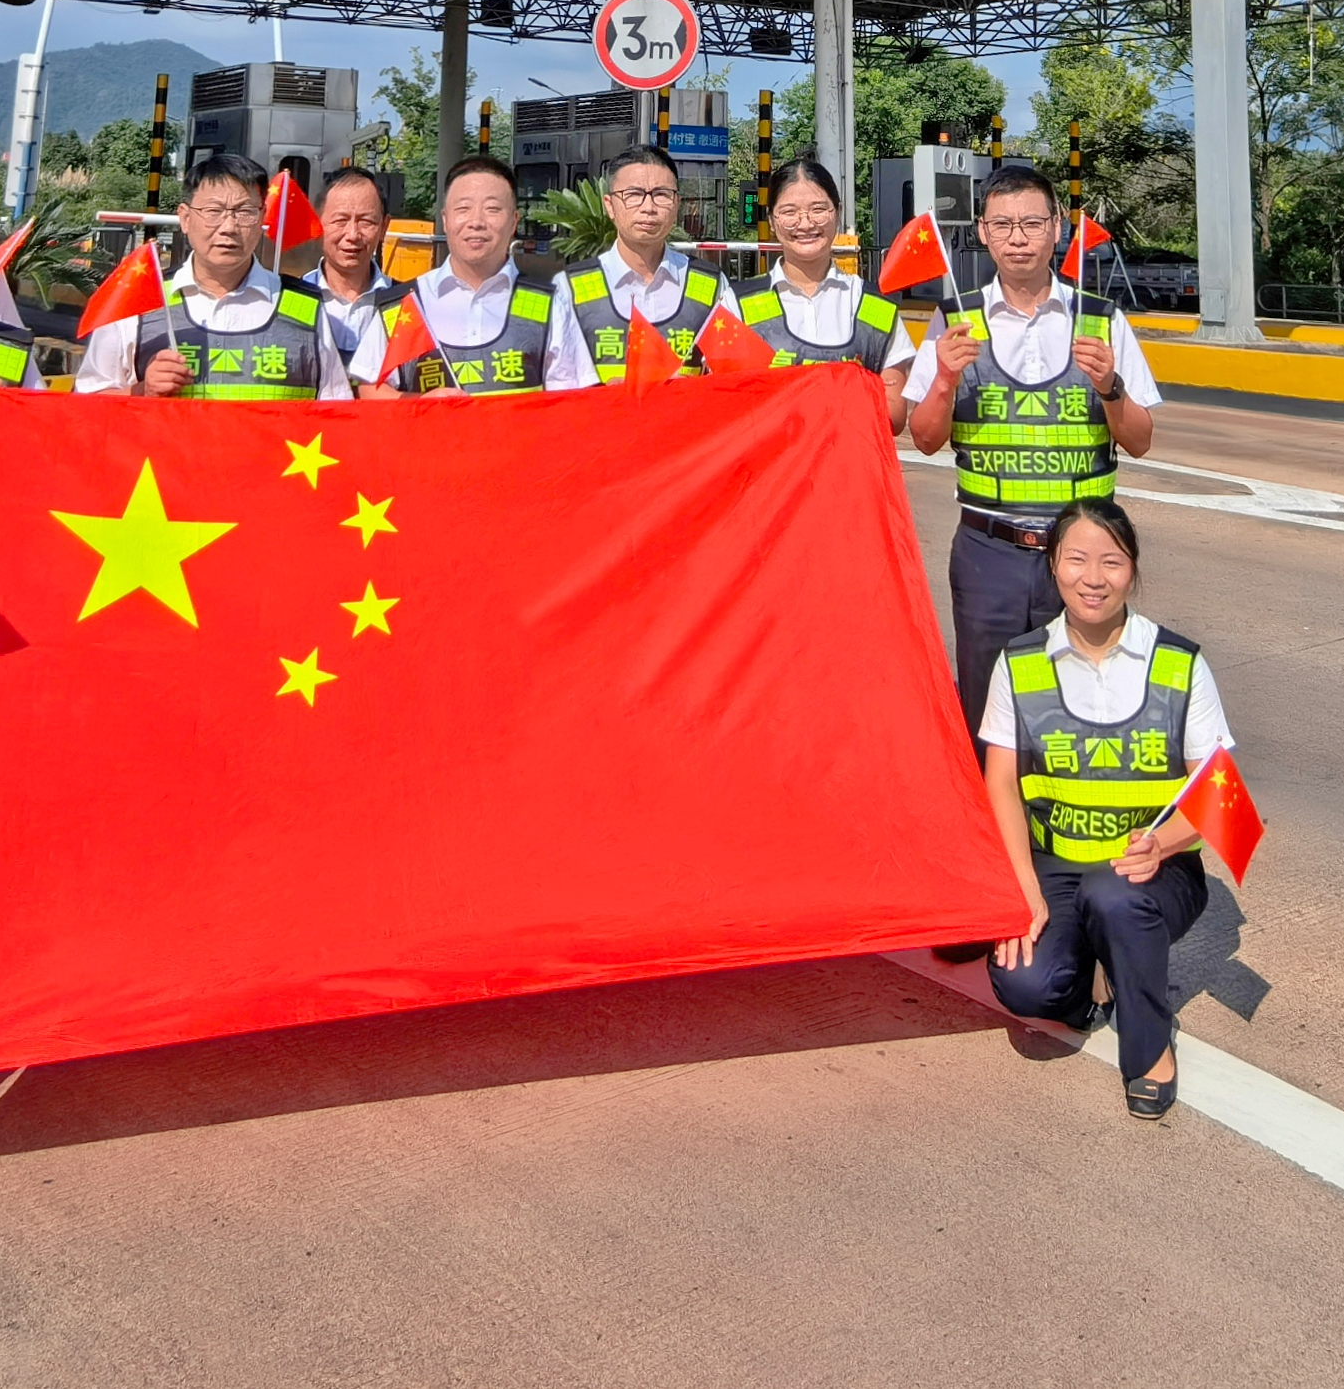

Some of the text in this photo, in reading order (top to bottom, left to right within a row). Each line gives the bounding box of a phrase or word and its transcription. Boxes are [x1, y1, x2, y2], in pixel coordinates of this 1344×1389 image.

[622, 16, 674, 61] 3m
[252, 344, 287, 380] 速
[595, 326, 624, 359] 高
[417, 348, 525, 393] 高 速
[977, 382, 1089, 421] 高 速
[970, 451, 1096, 473] EXPRESSWAY
[1040, 728, 1168, 773] 高 速
